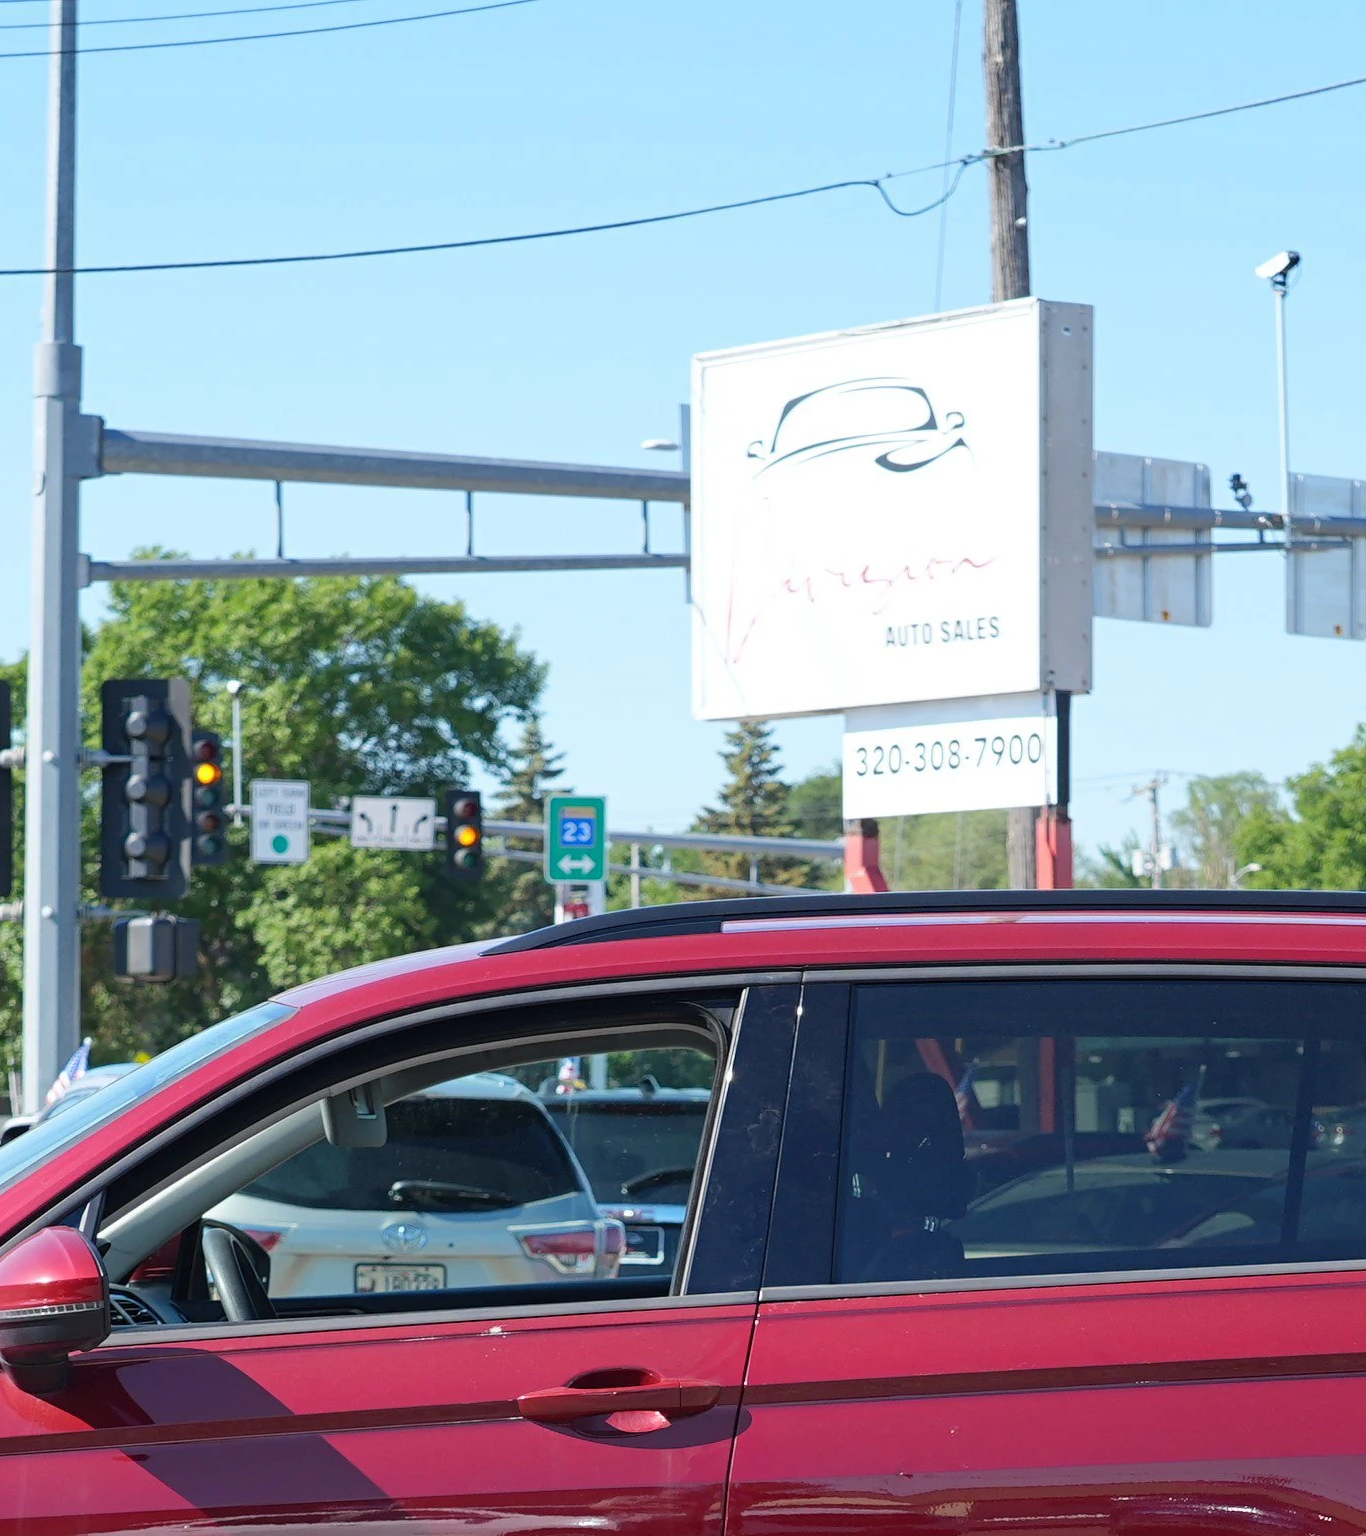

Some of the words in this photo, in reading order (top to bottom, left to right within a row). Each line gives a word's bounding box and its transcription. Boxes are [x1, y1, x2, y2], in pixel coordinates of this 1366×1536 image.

[885, 623, 933, 647] AUTO
[940, 616, 1001, 643] SALES
[856, 732, 1043, 777] 320-308-7900
[561, 820, 592, 843] 23
